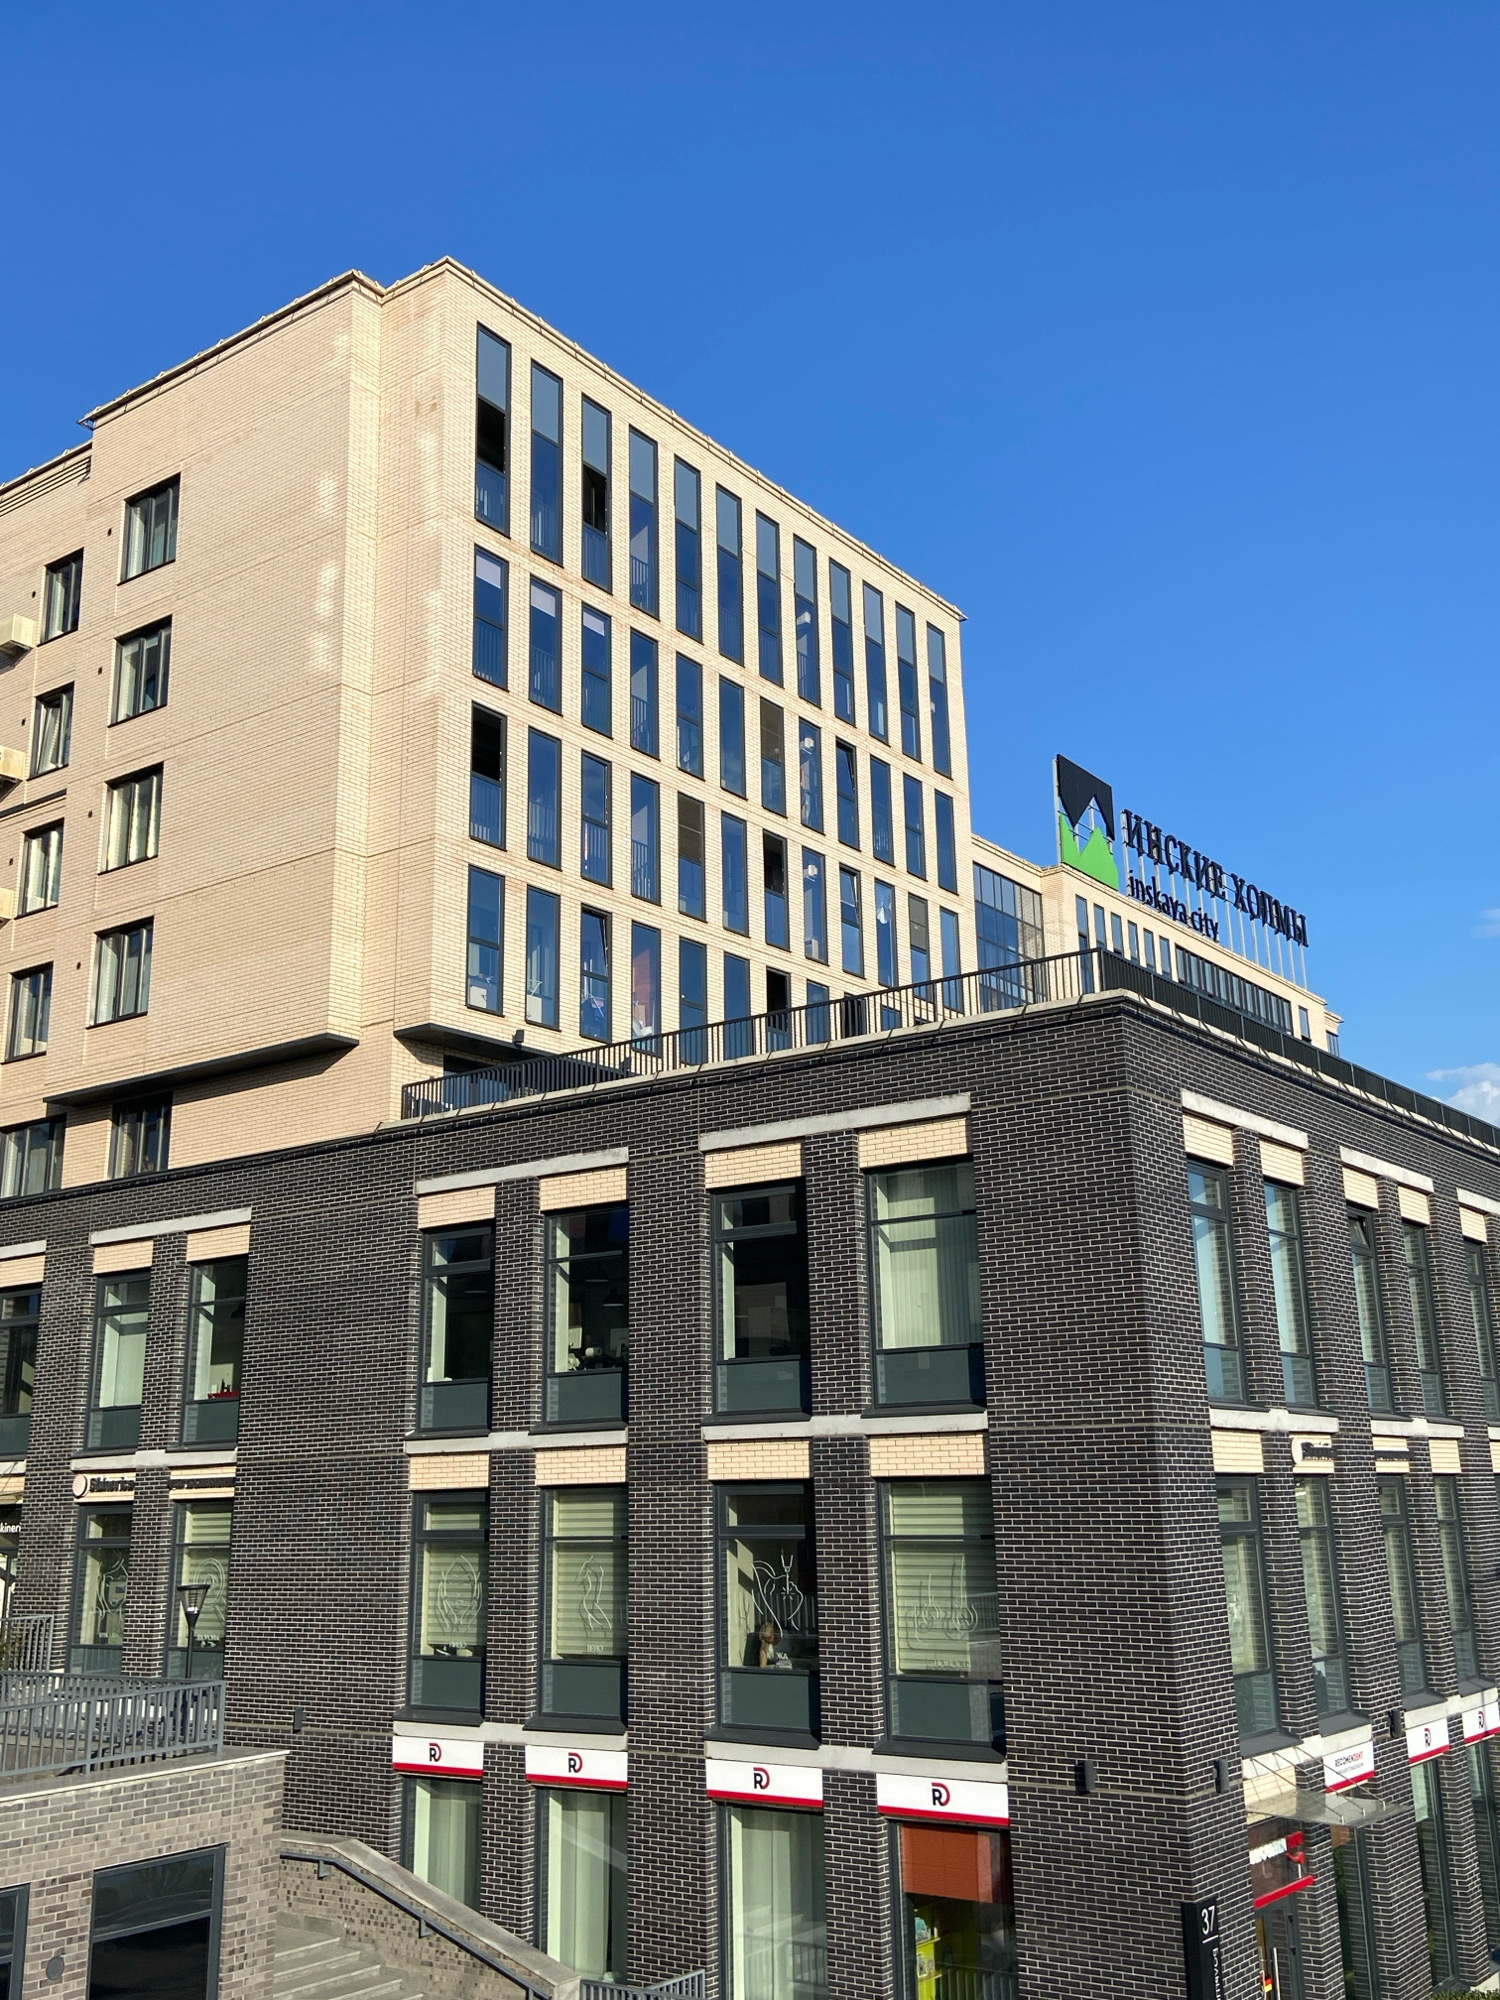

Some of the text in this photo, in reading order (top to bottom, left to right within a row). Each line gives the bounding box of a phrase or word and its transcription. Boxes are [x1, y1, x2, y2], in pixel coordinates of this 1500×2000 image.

[1124, 809, 1309, 947] ИНСКИЕ ХОЛМЫ
[1129, 870, 1219, 942] inskaya city
[1201, 1905, 1215, 1935] 37
